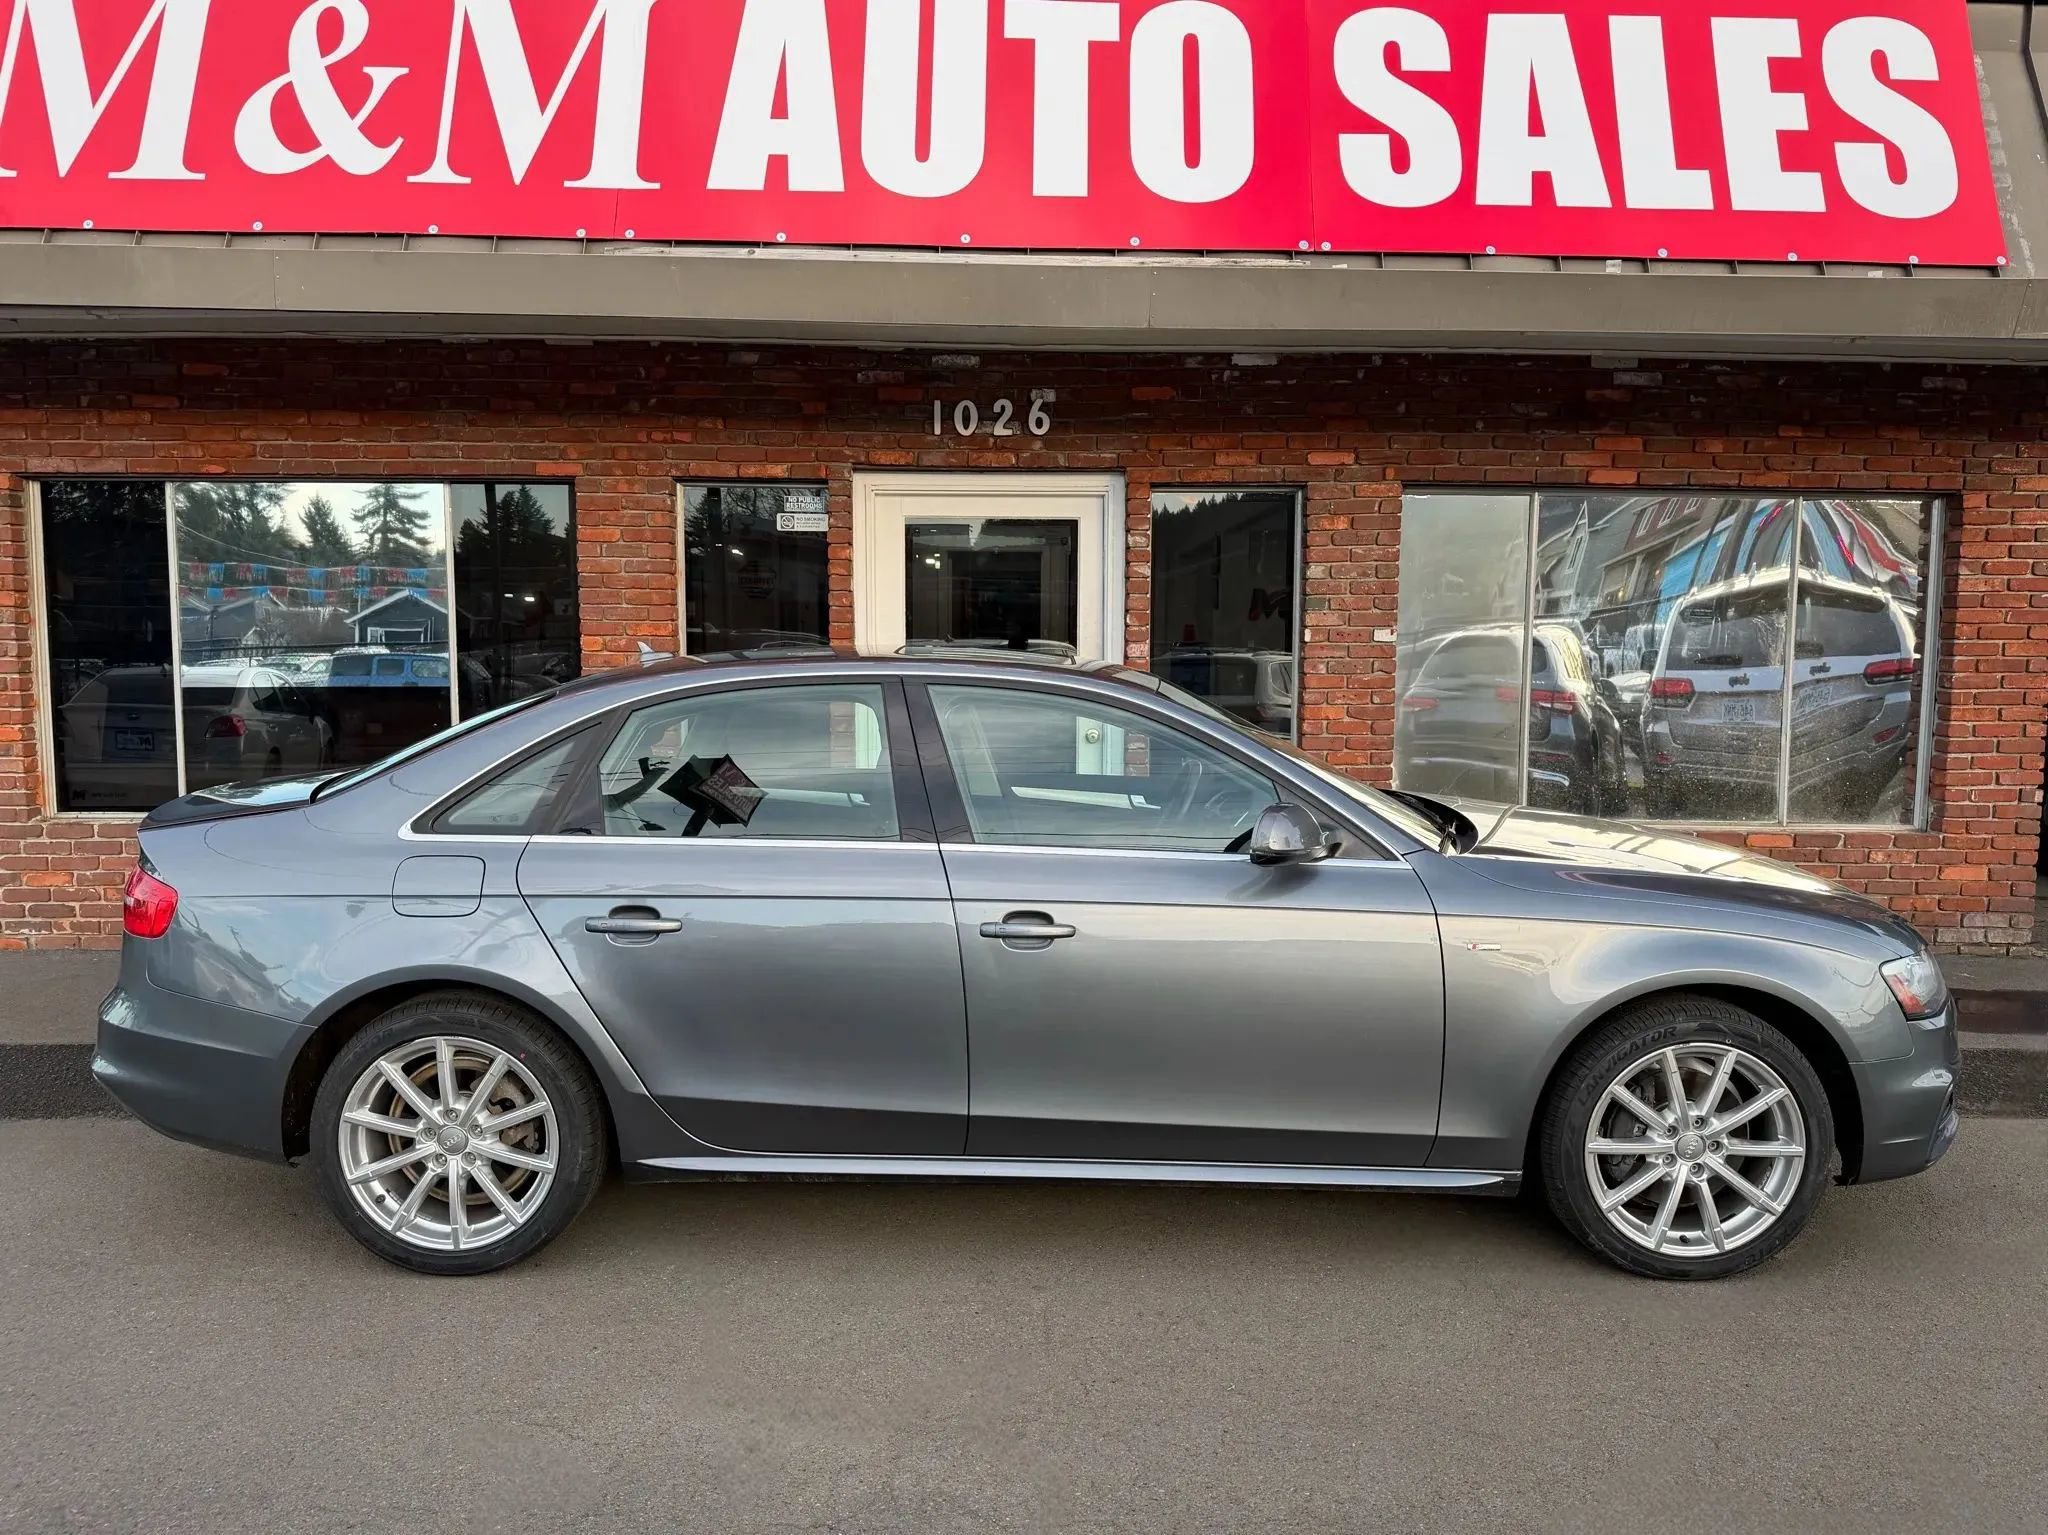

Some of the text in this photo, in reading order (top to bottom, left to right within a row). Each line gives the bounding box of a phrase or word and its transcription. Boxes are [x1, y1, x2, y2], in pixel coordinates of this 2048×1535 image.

[706, 0, 1255, 204] AUTO
[1333, 7, 1959, 219] SALES
[933, 398, 1051, 436] 1026
